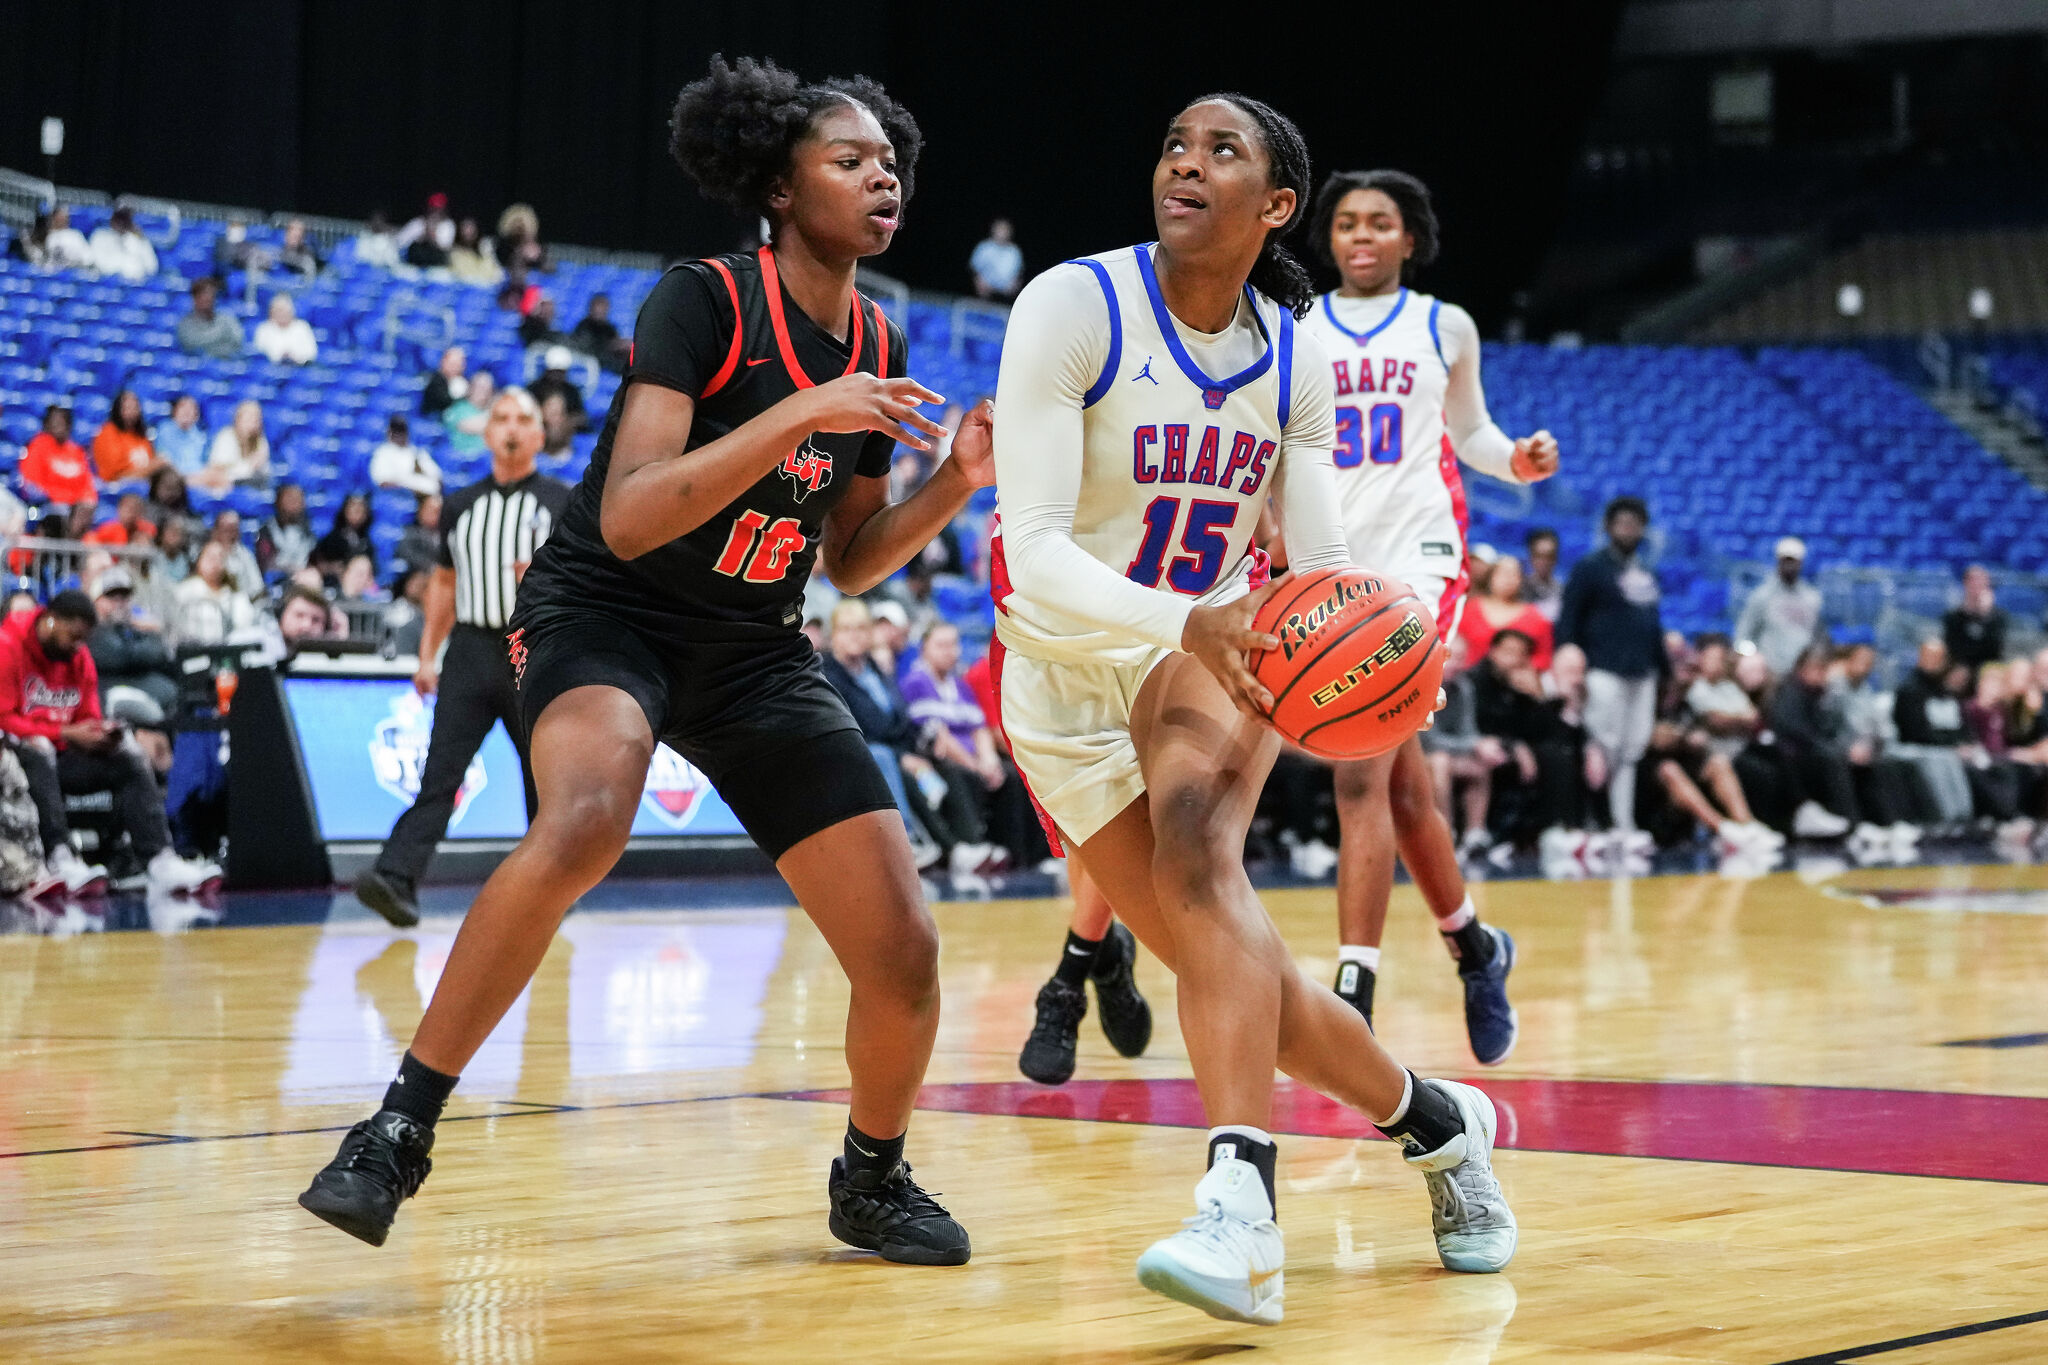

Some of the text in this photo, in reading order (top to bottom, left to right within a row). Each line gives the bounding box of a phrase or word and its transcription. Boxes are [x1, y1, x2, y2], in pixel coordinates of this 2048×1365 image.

[1332, 358, 1417, 396] HAPS
[1133, 423, 1278, 496] CHAPS
[1333, 402, 1404, 469] 30
[712, 508, 806, 584] 10
[1125, 494, 1240, 596] 15
[1279, 578, 1385, 662] Baden
[1309, 615, 1425, 709] ELITE PRO
[1389, 688, 1421, 718] NFHS
